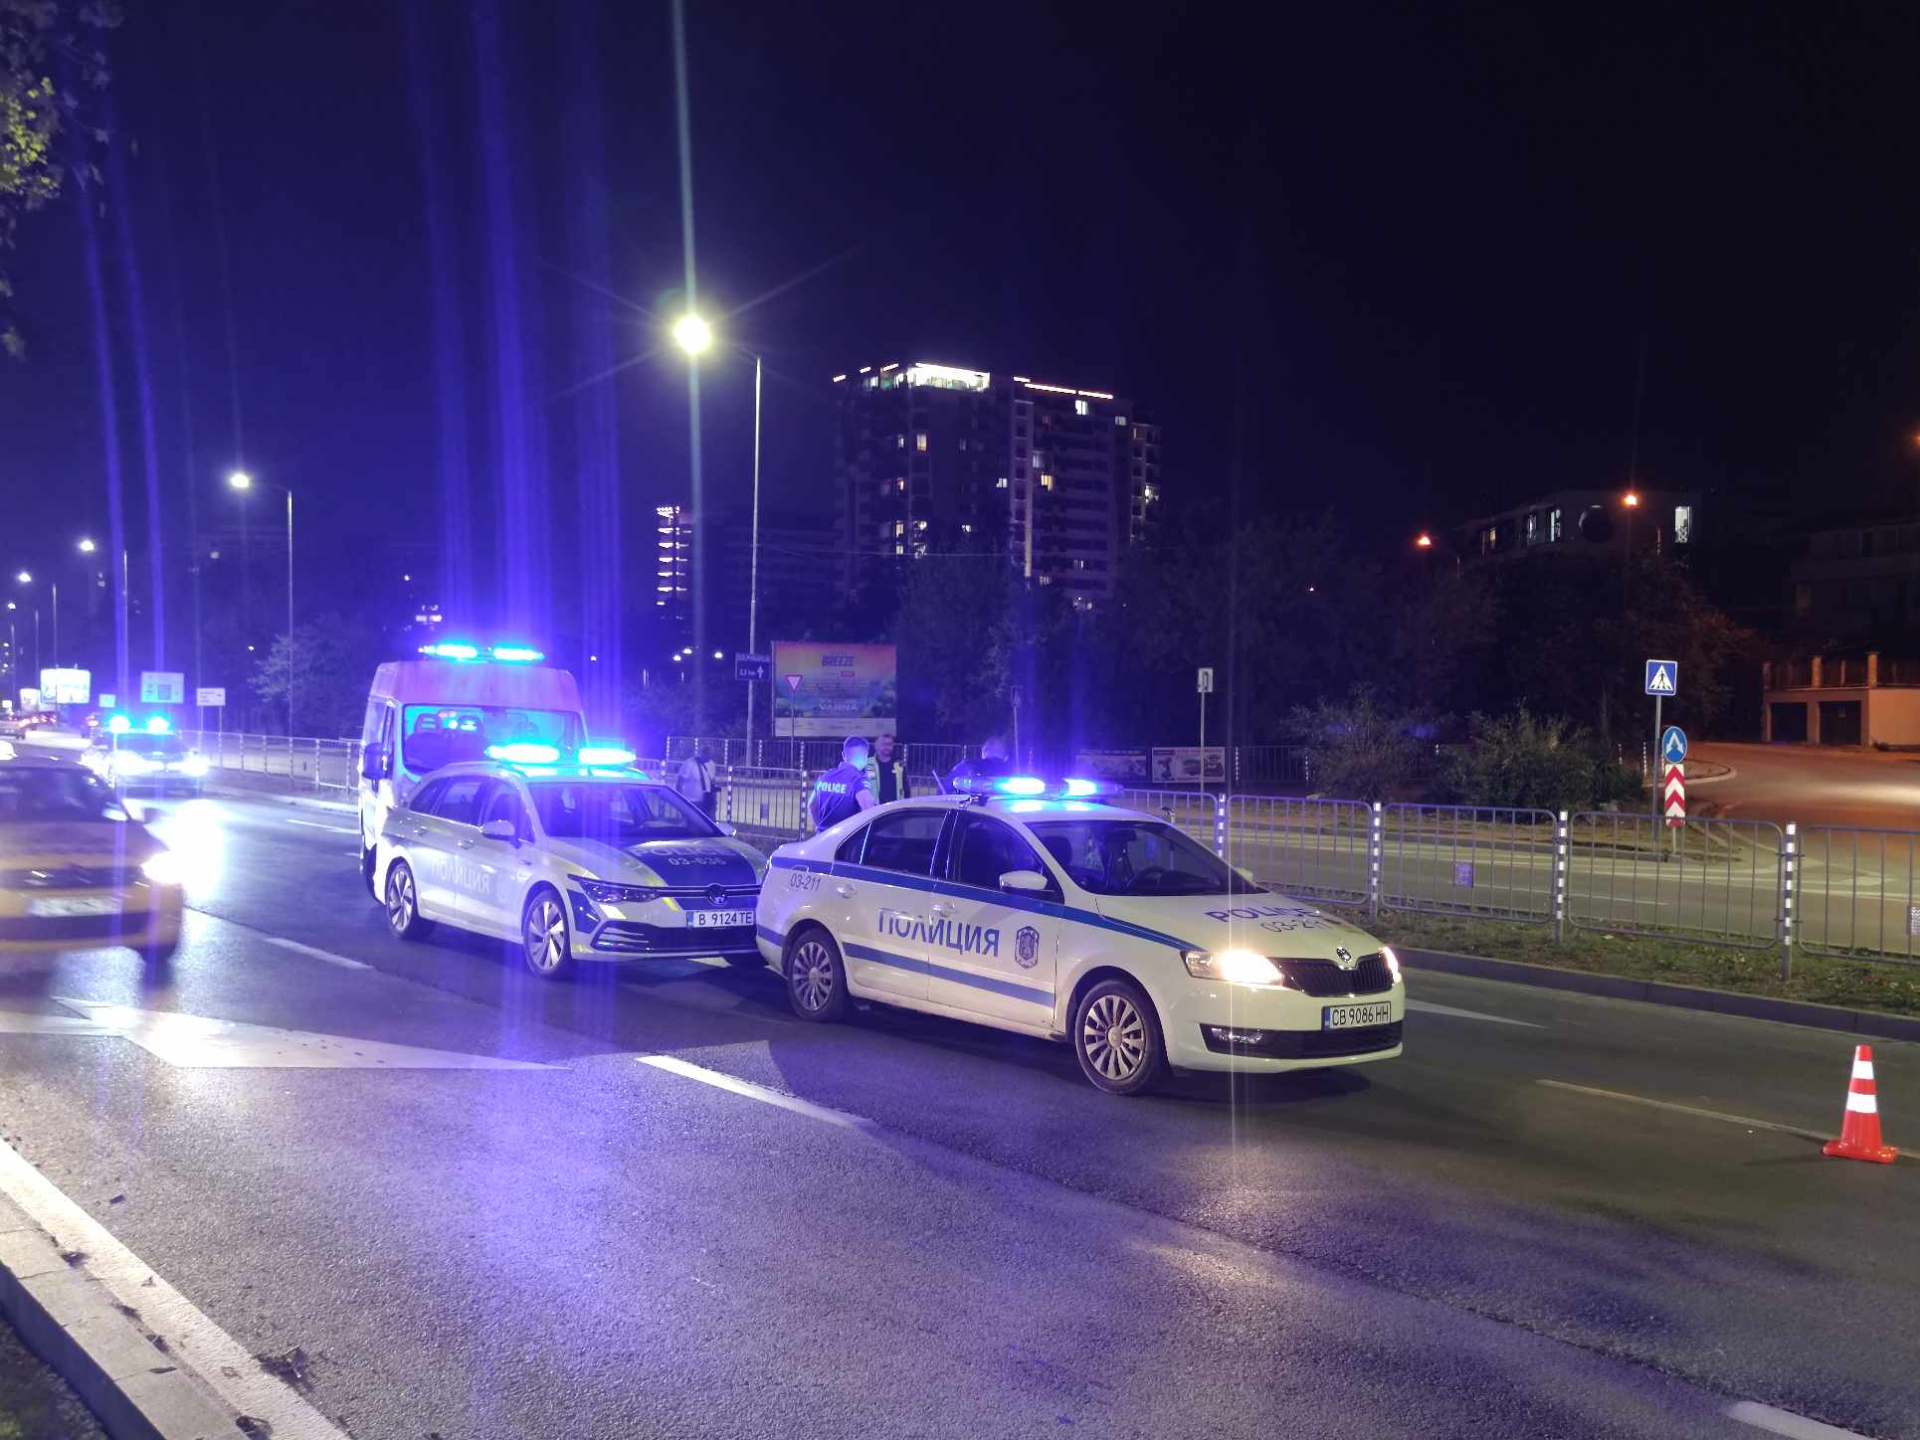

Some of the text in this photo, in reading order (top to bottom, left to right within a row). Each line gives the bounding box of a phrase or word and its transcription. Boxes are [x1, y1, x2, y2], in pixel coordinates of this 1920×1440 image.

[817, 781, 847, 794] POLICE
[431, 859, 490, 895] ПОЛИЦИЯ
[790, 873, 821, 891] 03-211
[711, 913, 737, 925] 9124
[1203, 906, 1323, 922] POLICE
[878, 907, 1000, 957] ПОЛИЦИЯ
[1332, 1005, 1389, 1026] CB 9086 HH
